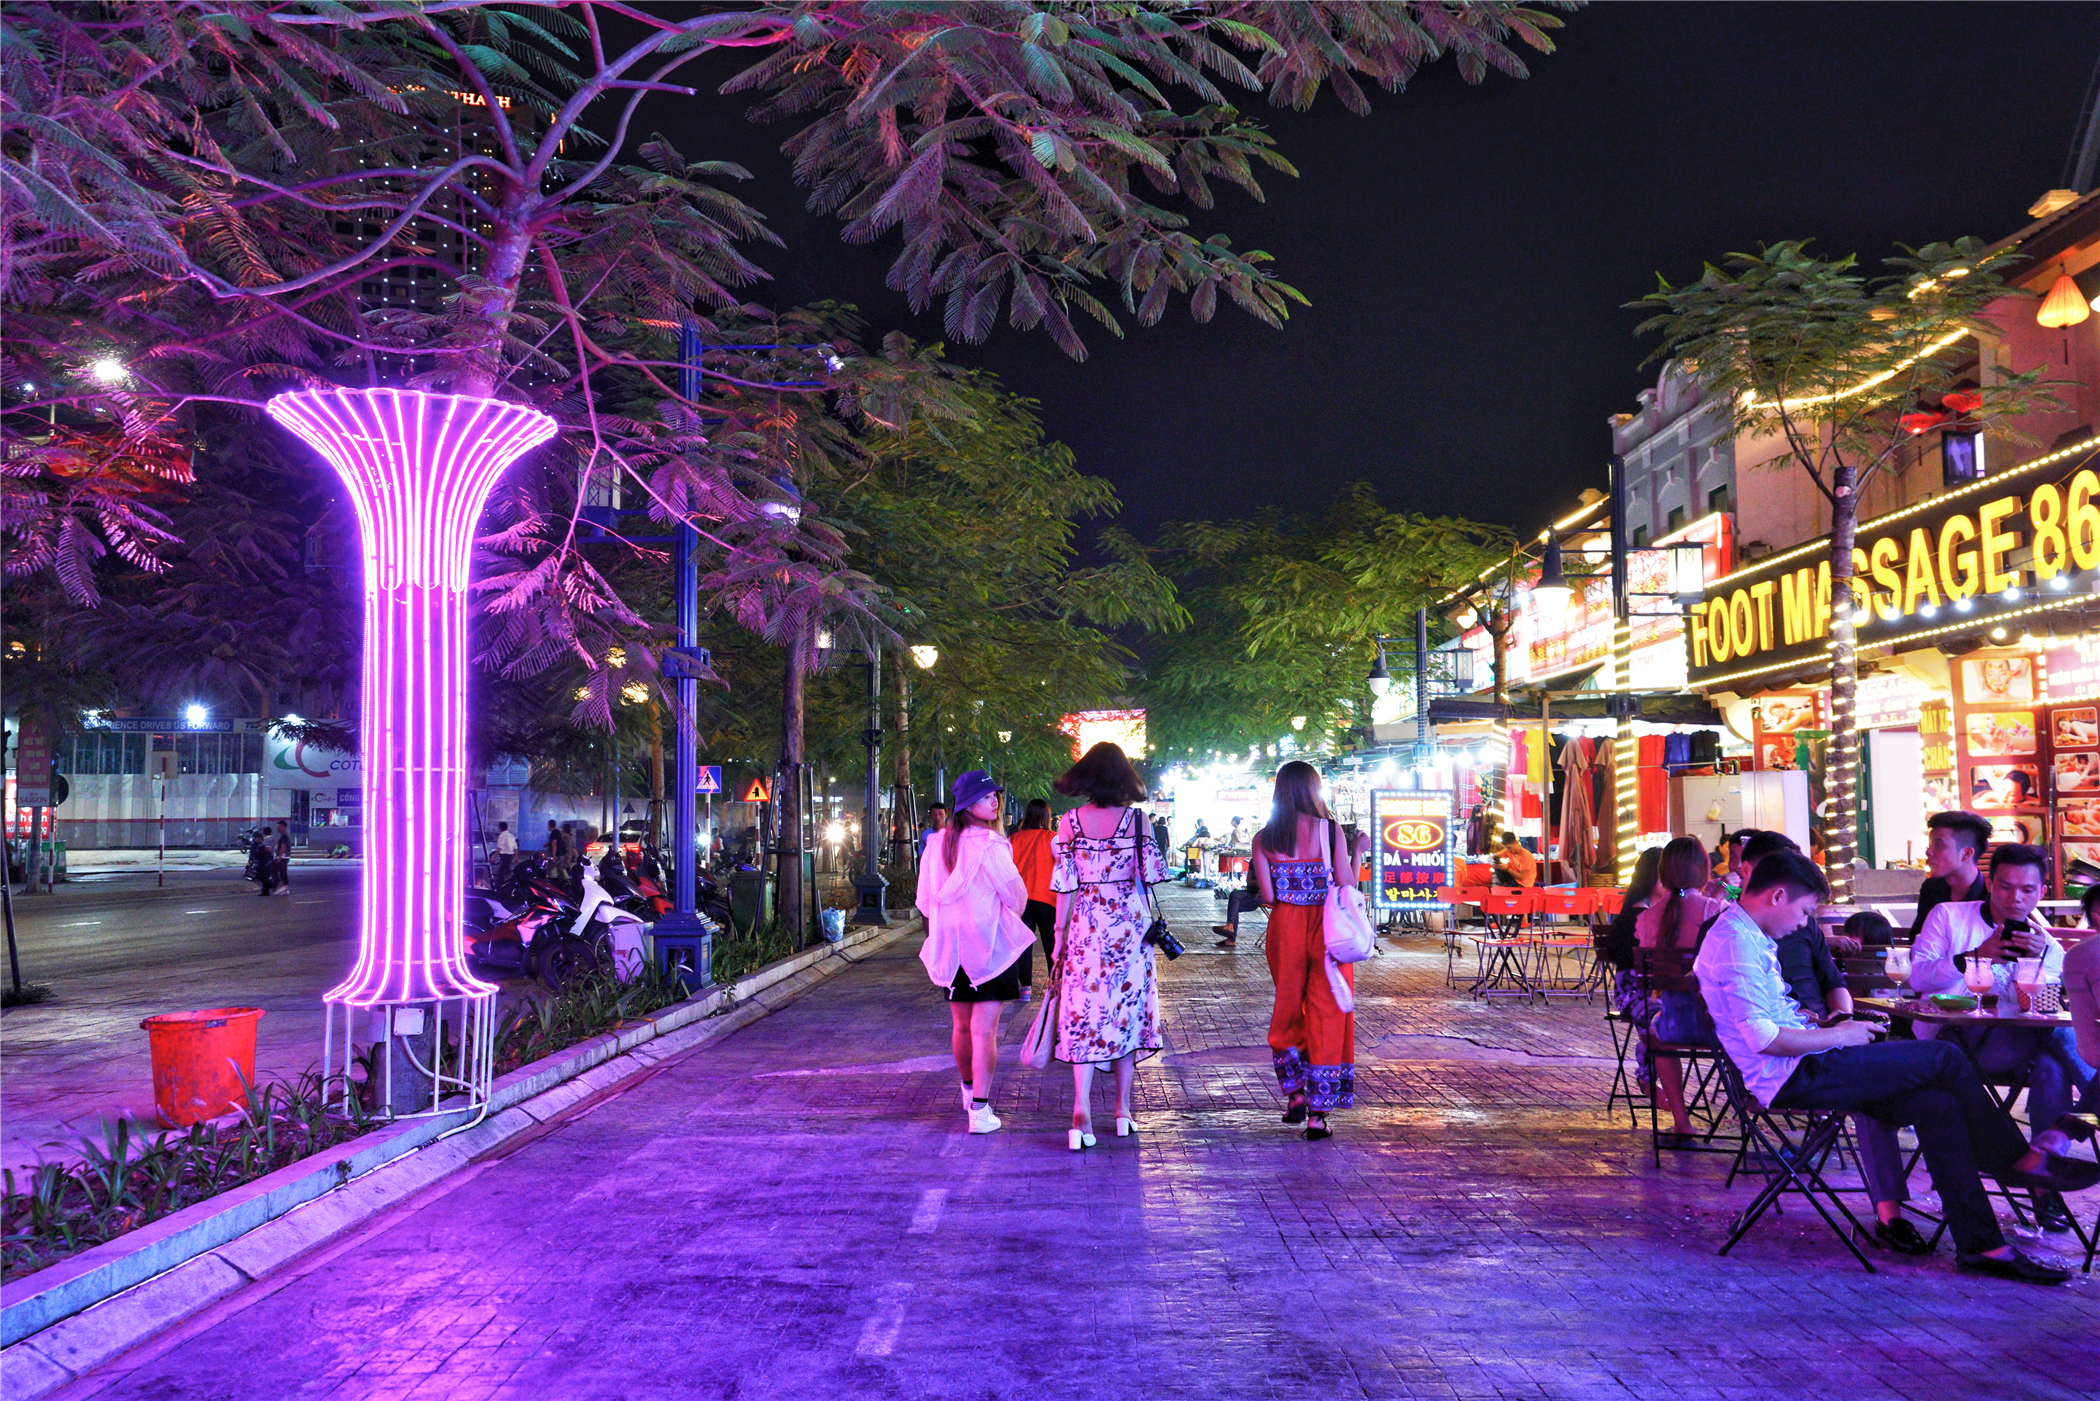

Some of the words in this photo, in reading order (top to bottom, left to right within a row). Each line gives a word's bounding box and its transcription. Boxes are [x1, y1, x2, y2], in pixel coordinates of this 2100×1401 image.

[450, 90, 512, 109] THAH
[1690, 580, 1777, 668] FOOT
[2030, 469, 2100, 581] 86
[140, 720, 172, 730] DRIVES
[173, 720, 186, 730] US
[187, 720, 231, 730] FORWARD
[1383, 849, 1402, 867] ĐÁ
[1411, 849, 1446, 867] MUỐI
[1383, 871, 1446, 884] 足部按摩
